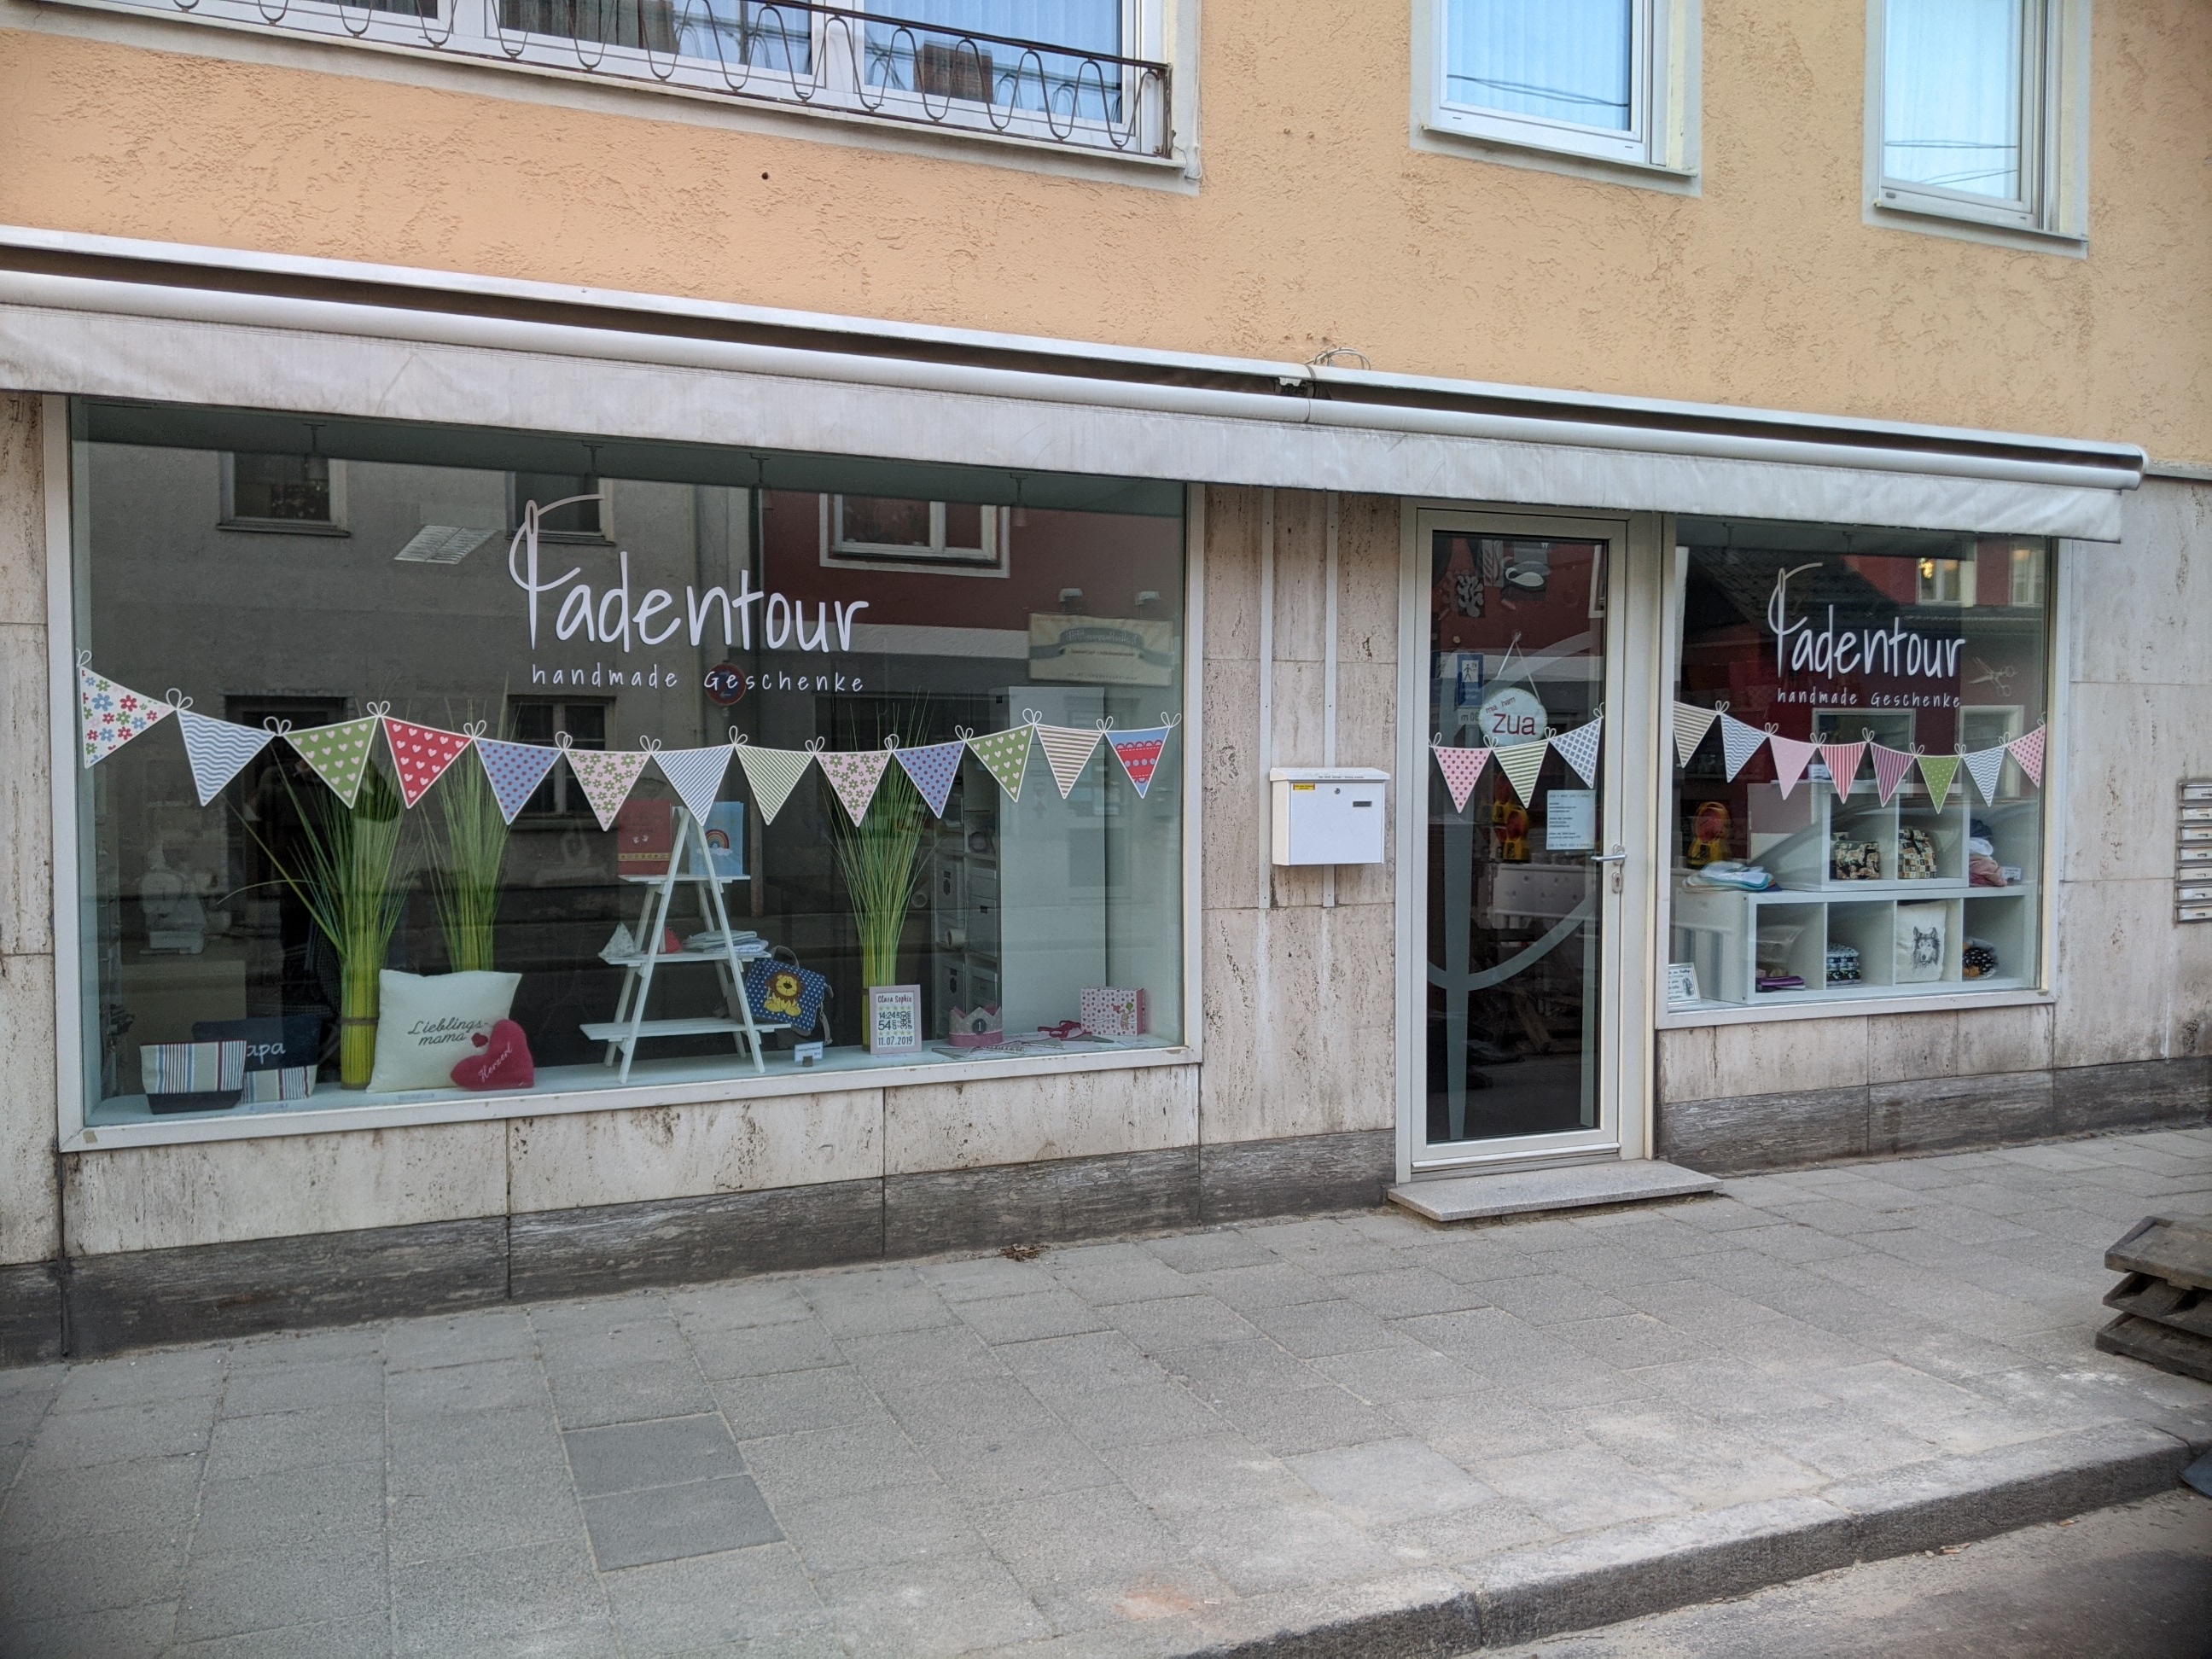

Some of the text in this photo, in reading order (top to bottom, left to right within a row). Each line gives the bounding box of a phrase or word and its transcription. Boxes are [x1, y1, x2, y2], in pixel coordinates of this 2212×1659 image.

[509, 494, 869, 653] Fadentour
[1768, 562, 1966, 679] Fadentour
[532, 662, 864, 692] handmade Geschenke
[1778, 686, 1960, 708] handmade Geschenke
[877, 995, 894, 1004] Clara
[407, 1016, 490, 1035] Lieblings-
[877, 1020, 892, 1031] 54
[418, 1033, 467, 1045] mama
[878, 1036, 913, 1046] 11.07.2019
[247, 1042, 286, 1065] apa
